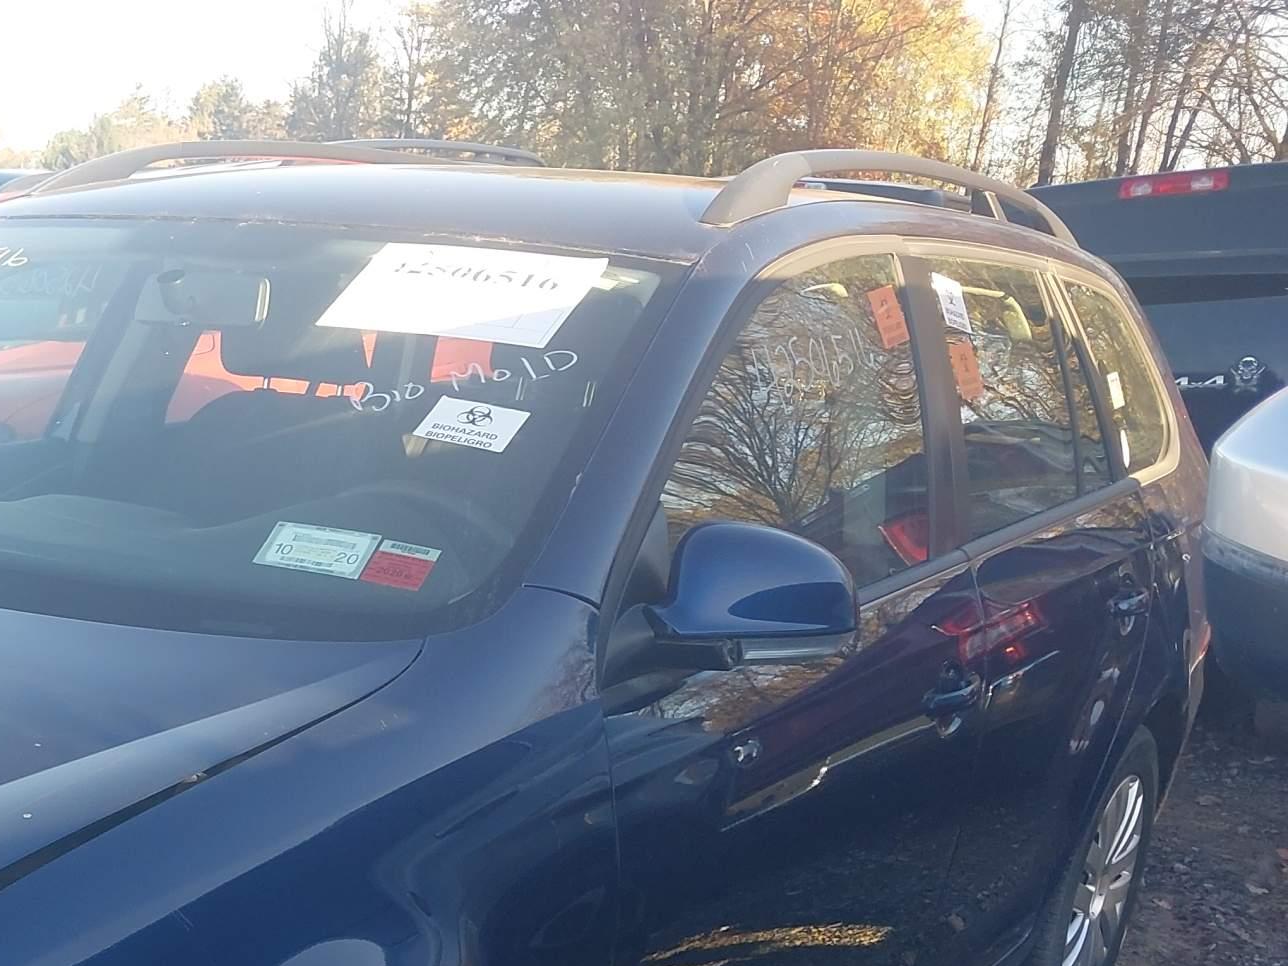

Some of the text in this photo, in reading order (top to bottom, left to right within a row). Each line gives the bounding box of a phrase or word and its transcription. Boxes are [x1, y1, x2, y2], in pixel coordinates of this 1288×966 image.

[424, 430, 493, 450] BIOPELIGRO
[431, 422, 499, 441] BIOHAZARD
[274, 542, 294, 556] 10
[334, 551, 360, 565] 20
